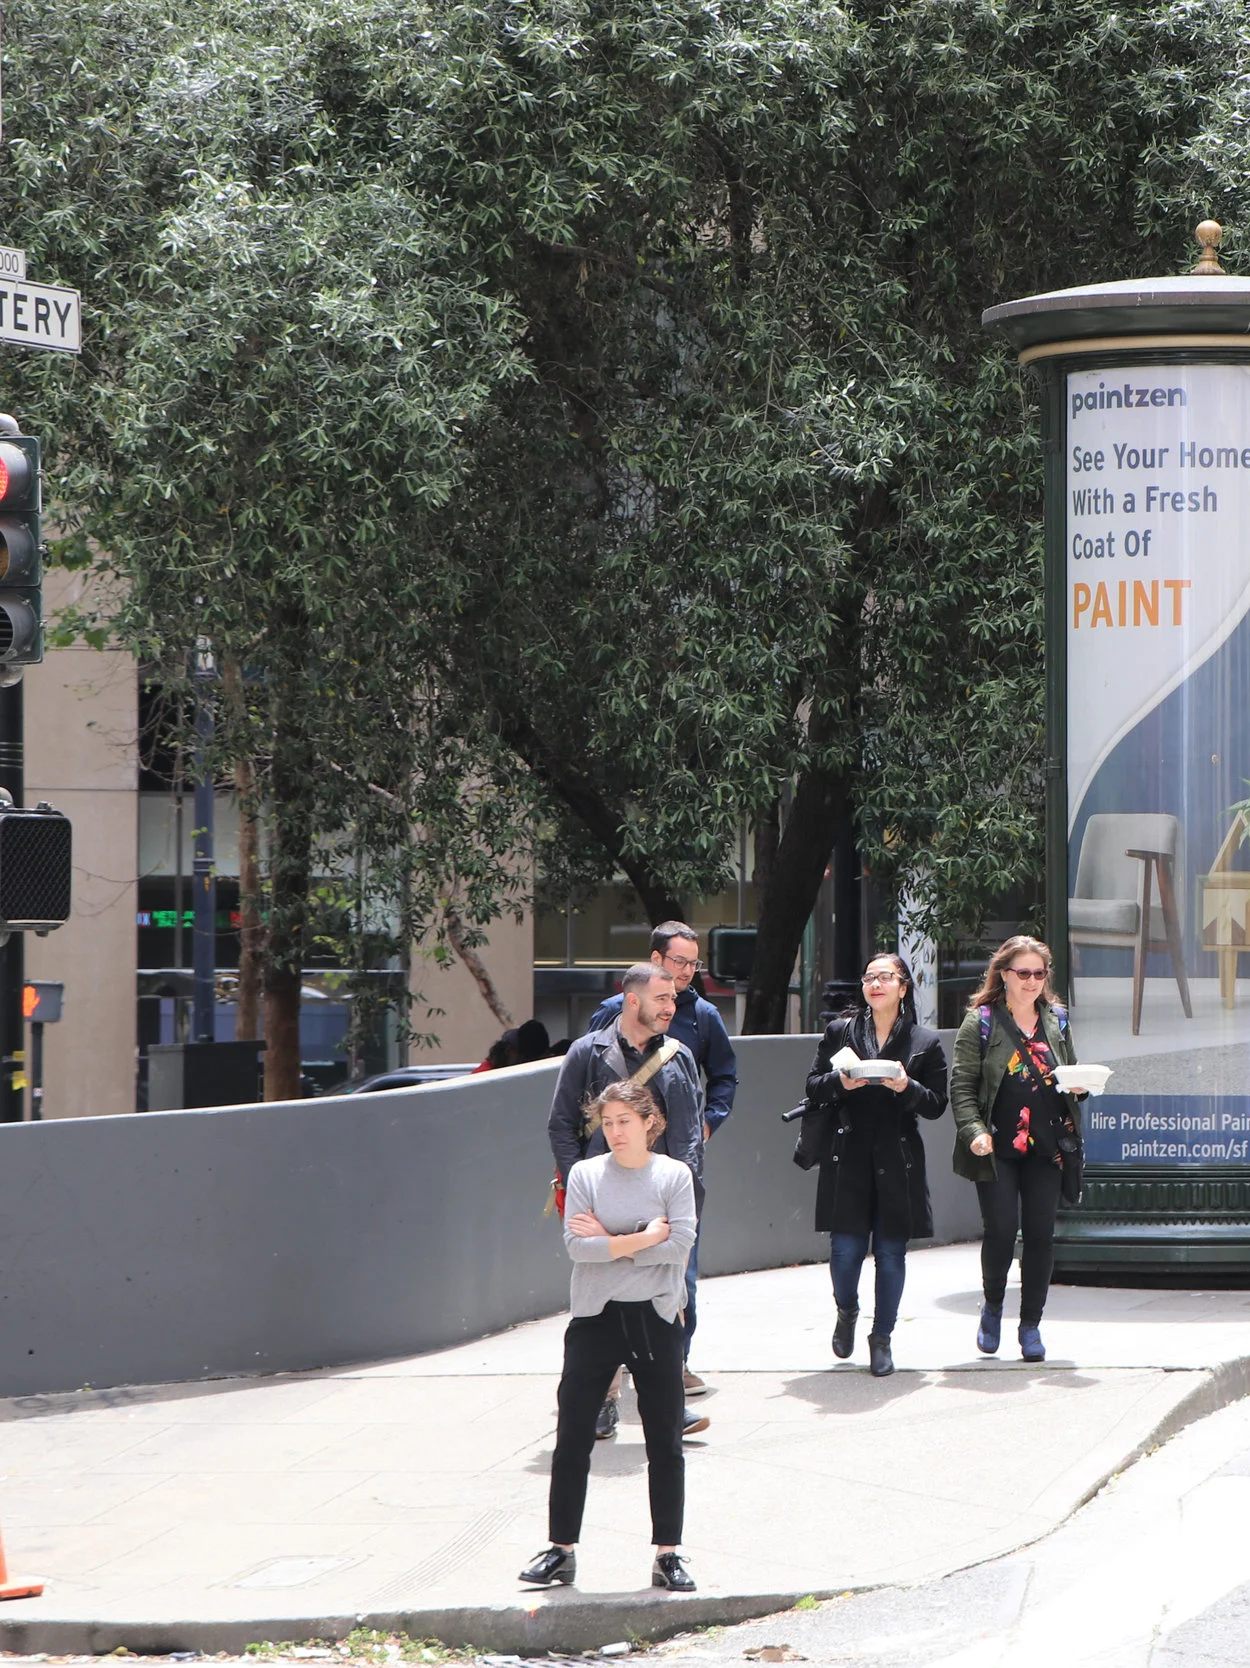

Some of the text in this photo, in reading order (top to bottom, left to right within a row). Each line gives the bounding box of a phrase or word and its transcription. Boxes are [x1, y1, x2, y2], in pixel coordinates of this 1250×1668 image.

[1071, 382, 1187, 419] paintzen
[1072, 446, 1105, 473] See
[1112, 443, 1169, 469] Your
[1072, 485, 1217, 516] With a Fresh
[1072, 529, 1151, 560] Coat Of
[1073, 579, 1192, 629] PAINT
[1091, 1112, 1116, 1130] Hire
[1120, 1113, 1216, 1131] Professional
[1121, 1138, 1249, 1161] paintzen.com/sf
